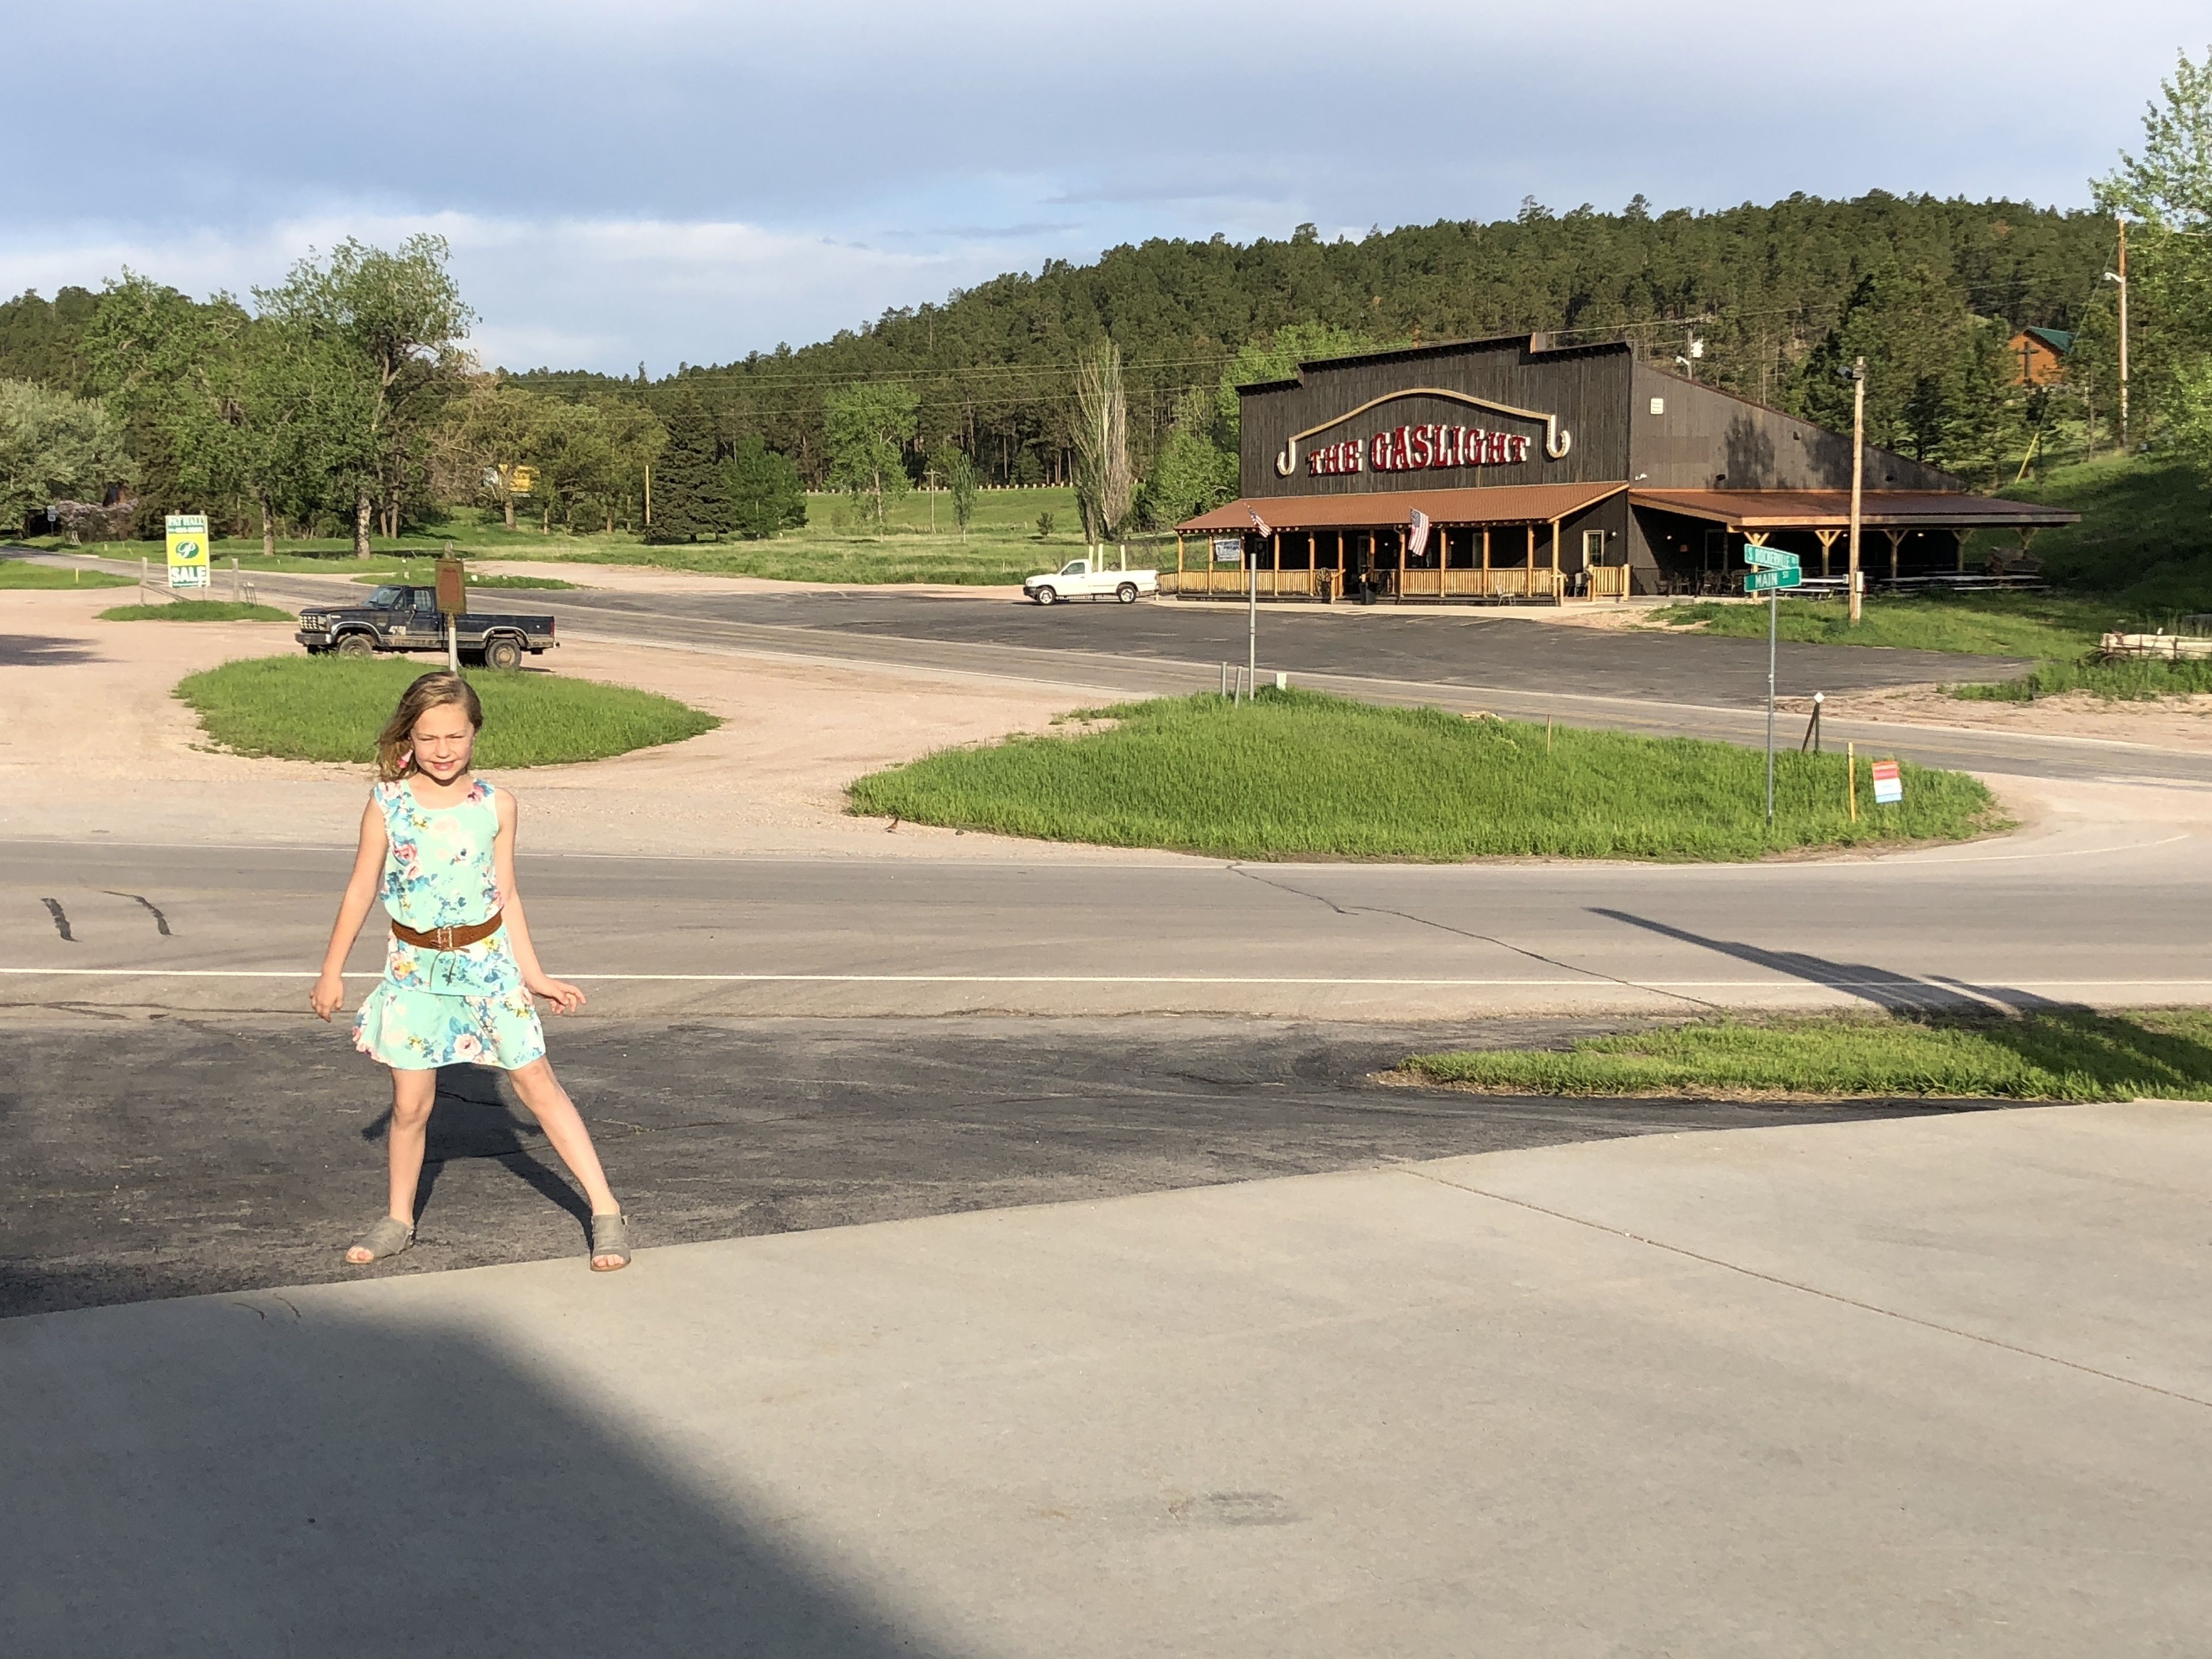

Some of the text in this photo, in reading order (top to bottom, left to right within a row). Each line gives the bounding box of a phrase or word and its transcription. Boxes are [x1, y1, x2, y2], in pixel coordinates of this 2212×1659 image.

[1308, 424, 1531, 475] THE GASLIGHT
[171, 566, 206, 582] SALE
[1755, 573, 1778, 588] MAIN
